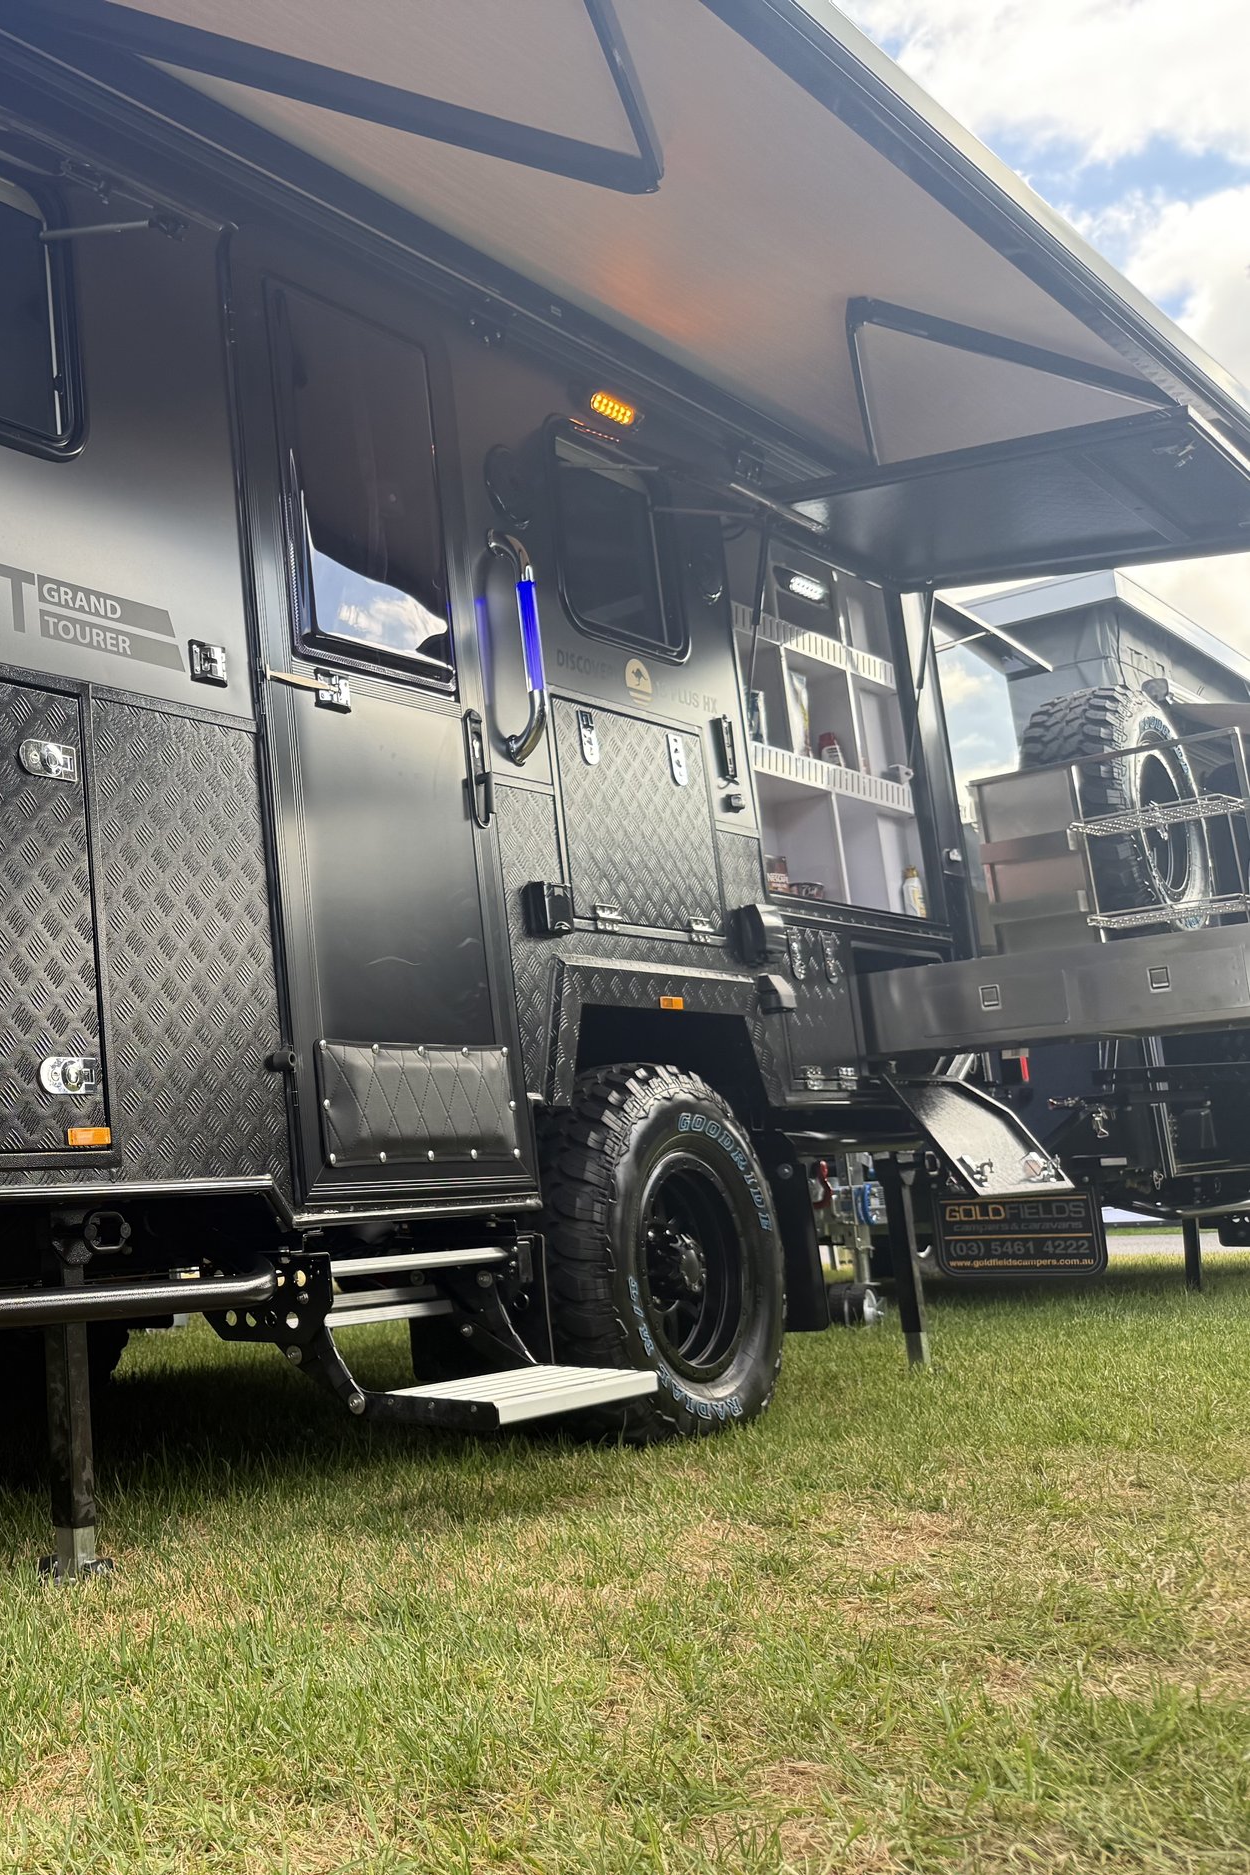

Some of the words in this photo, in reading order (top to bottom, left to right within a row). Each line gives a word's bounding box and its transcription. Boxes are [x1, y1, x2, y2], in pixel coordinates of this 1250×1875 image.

[42, 583, 122, 619] GRAND
[44, 615, 132, 655] TOURER
[703, 694, 718, 714] HX
[677, 1112, 773, 1232] GOODRIDE
[946, 1202, 1086, 1221] GOLDFIELDS
[950, 1241, 985, 1256] (03)
[991, 1241, 1035, 1254] 5461
[1043, 1240, 1090, 1254] 4222
[949, 1257, 1094, 1268] www.goldfieldscampers.com.au
[658, 1364, 744, 1421] RADIAL
